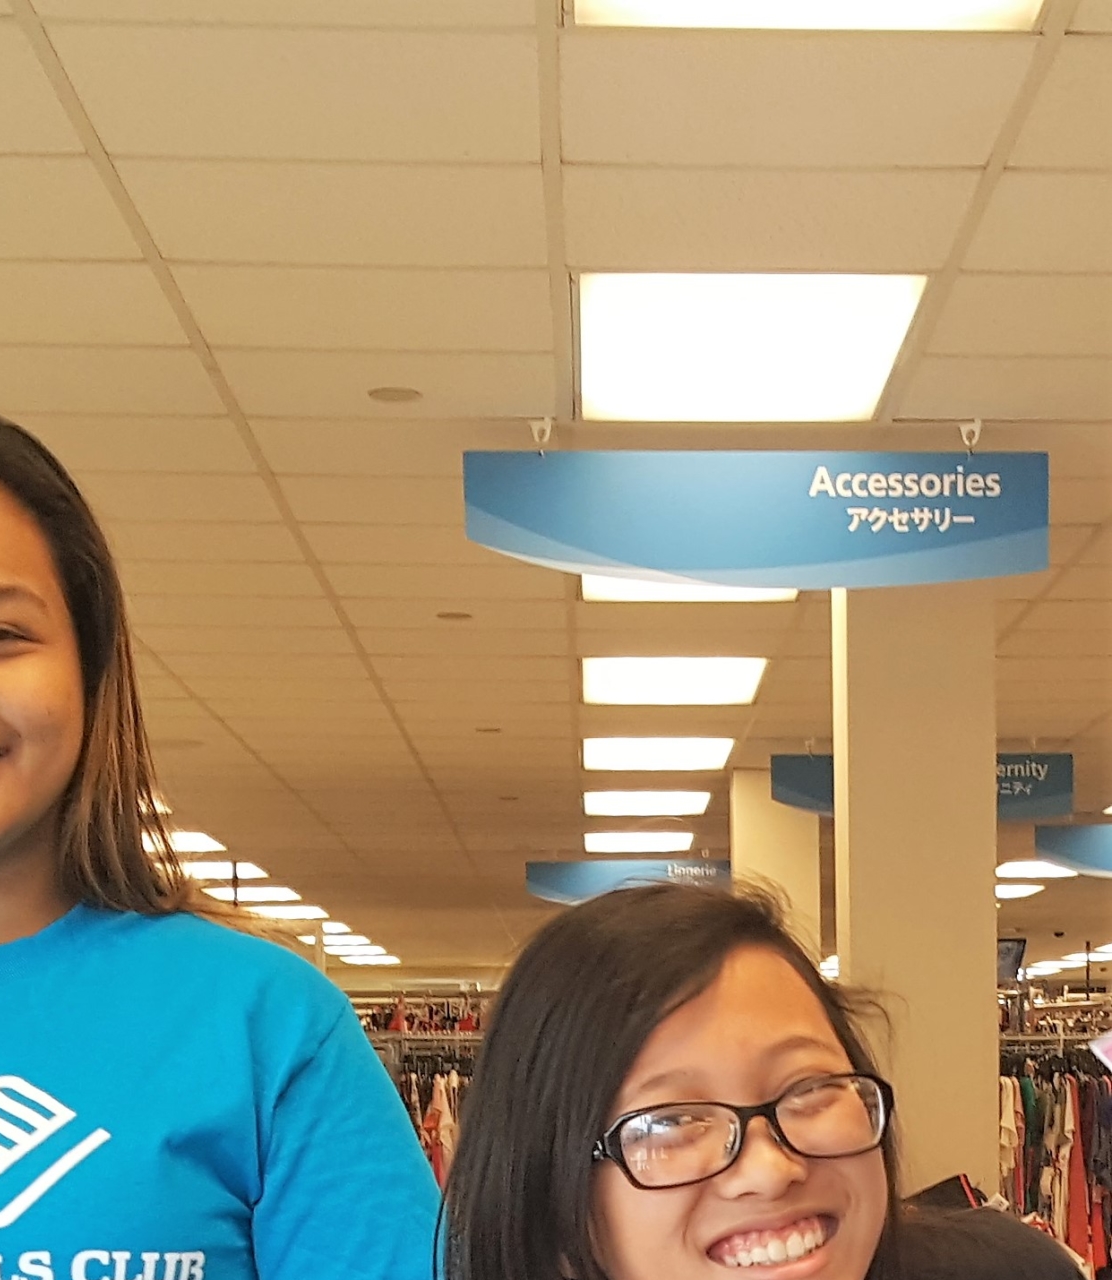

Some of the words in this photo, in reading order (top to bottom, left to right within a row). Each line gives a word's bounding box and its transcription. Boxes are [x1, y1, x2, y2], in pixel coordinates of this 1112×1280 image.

[808, 465, 1002, 498] Accessories
[847, 507, 976, 533] アクセサリー
